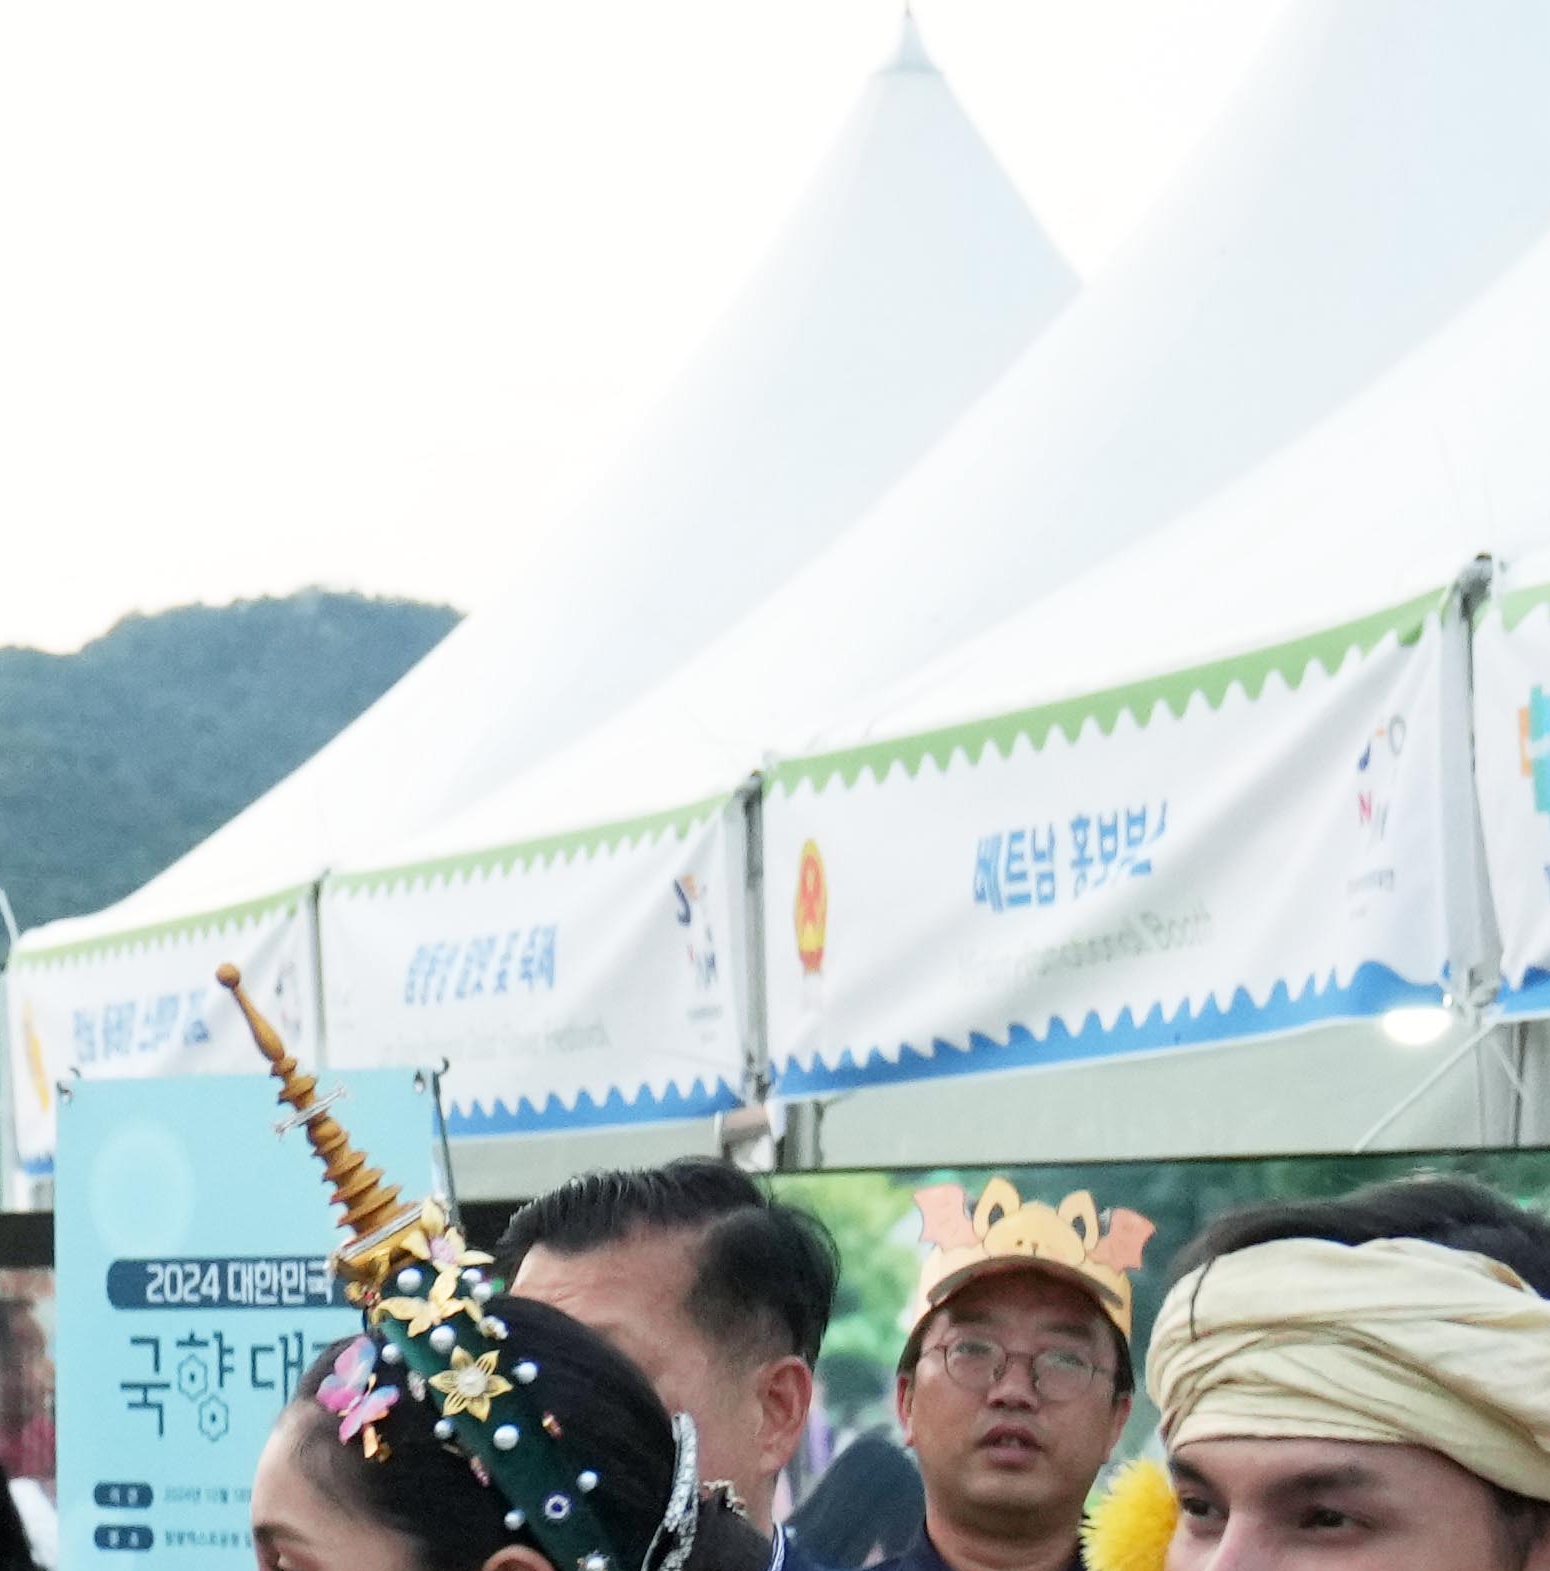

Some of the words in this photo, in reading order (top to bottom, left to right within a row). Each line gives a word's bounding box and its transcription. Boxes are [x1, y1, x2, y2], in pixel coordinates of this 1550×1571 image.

[973, 821, 1057, 912] 베트남
[145, 1262, 221, 1303] 2024
[227, 1260, 336, 1306] 대한민국
[119, 1329, 330, 1442] 국향대
